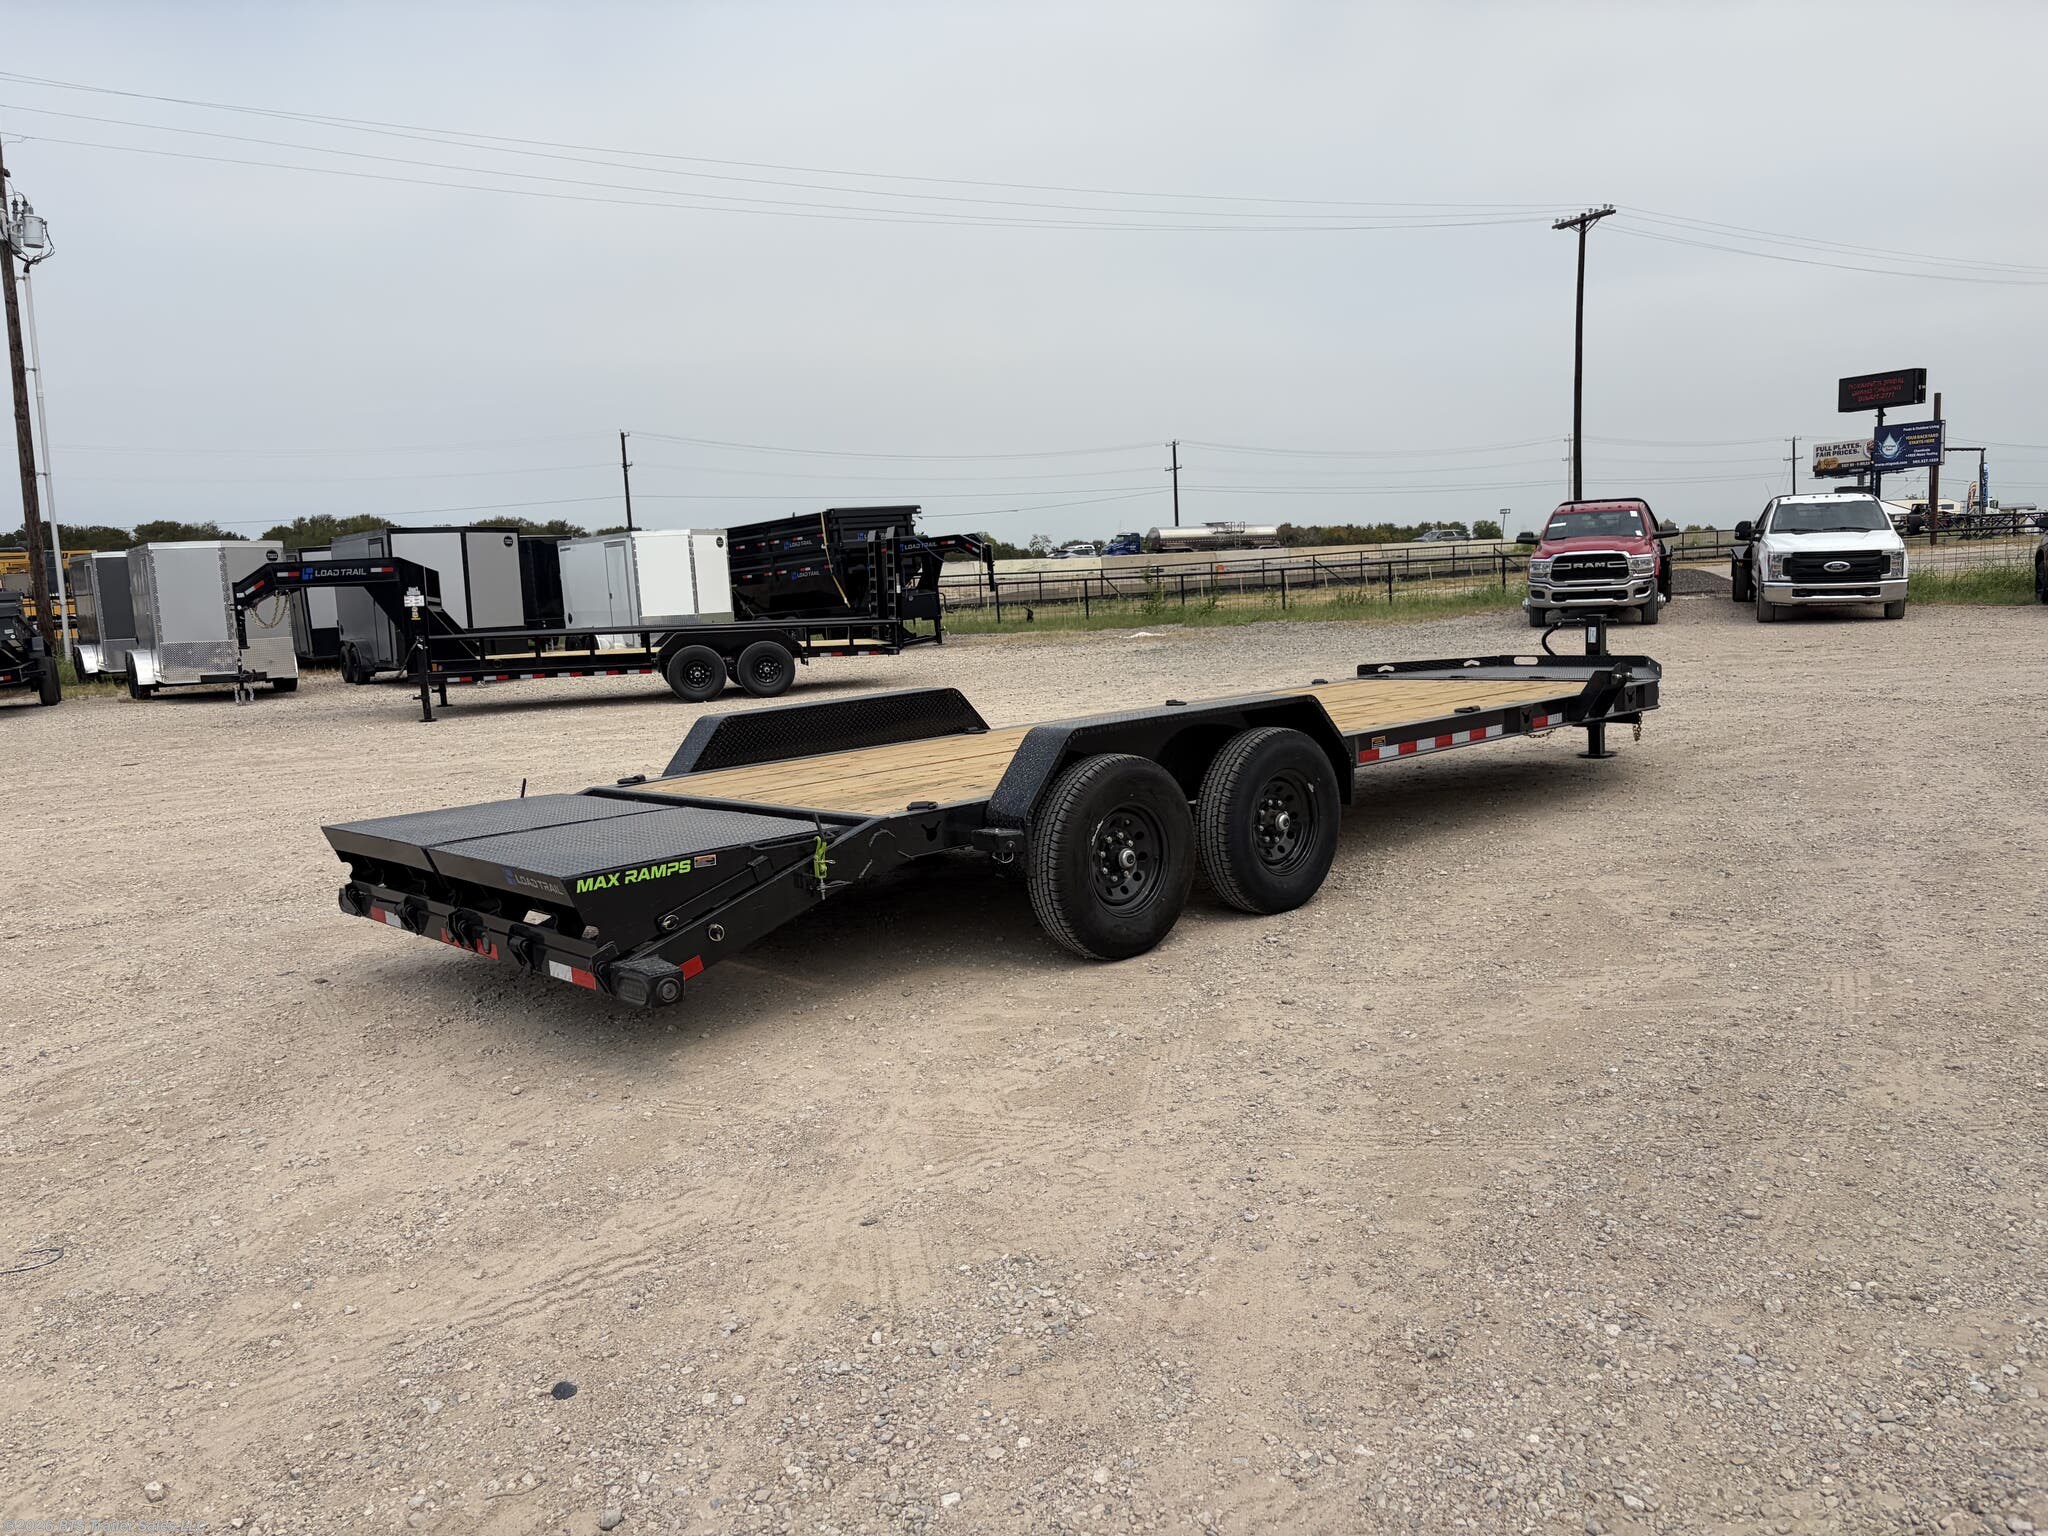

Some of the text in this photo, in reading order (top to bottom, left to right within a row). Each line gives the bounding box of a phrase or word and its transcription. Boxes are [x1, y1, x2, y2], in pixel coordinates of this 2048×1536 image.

[315, 567, 367, 577] LOAD TRAIL
[576, 872, 620, 893] MAX
[625, 859, 692, 884] RAMPS
